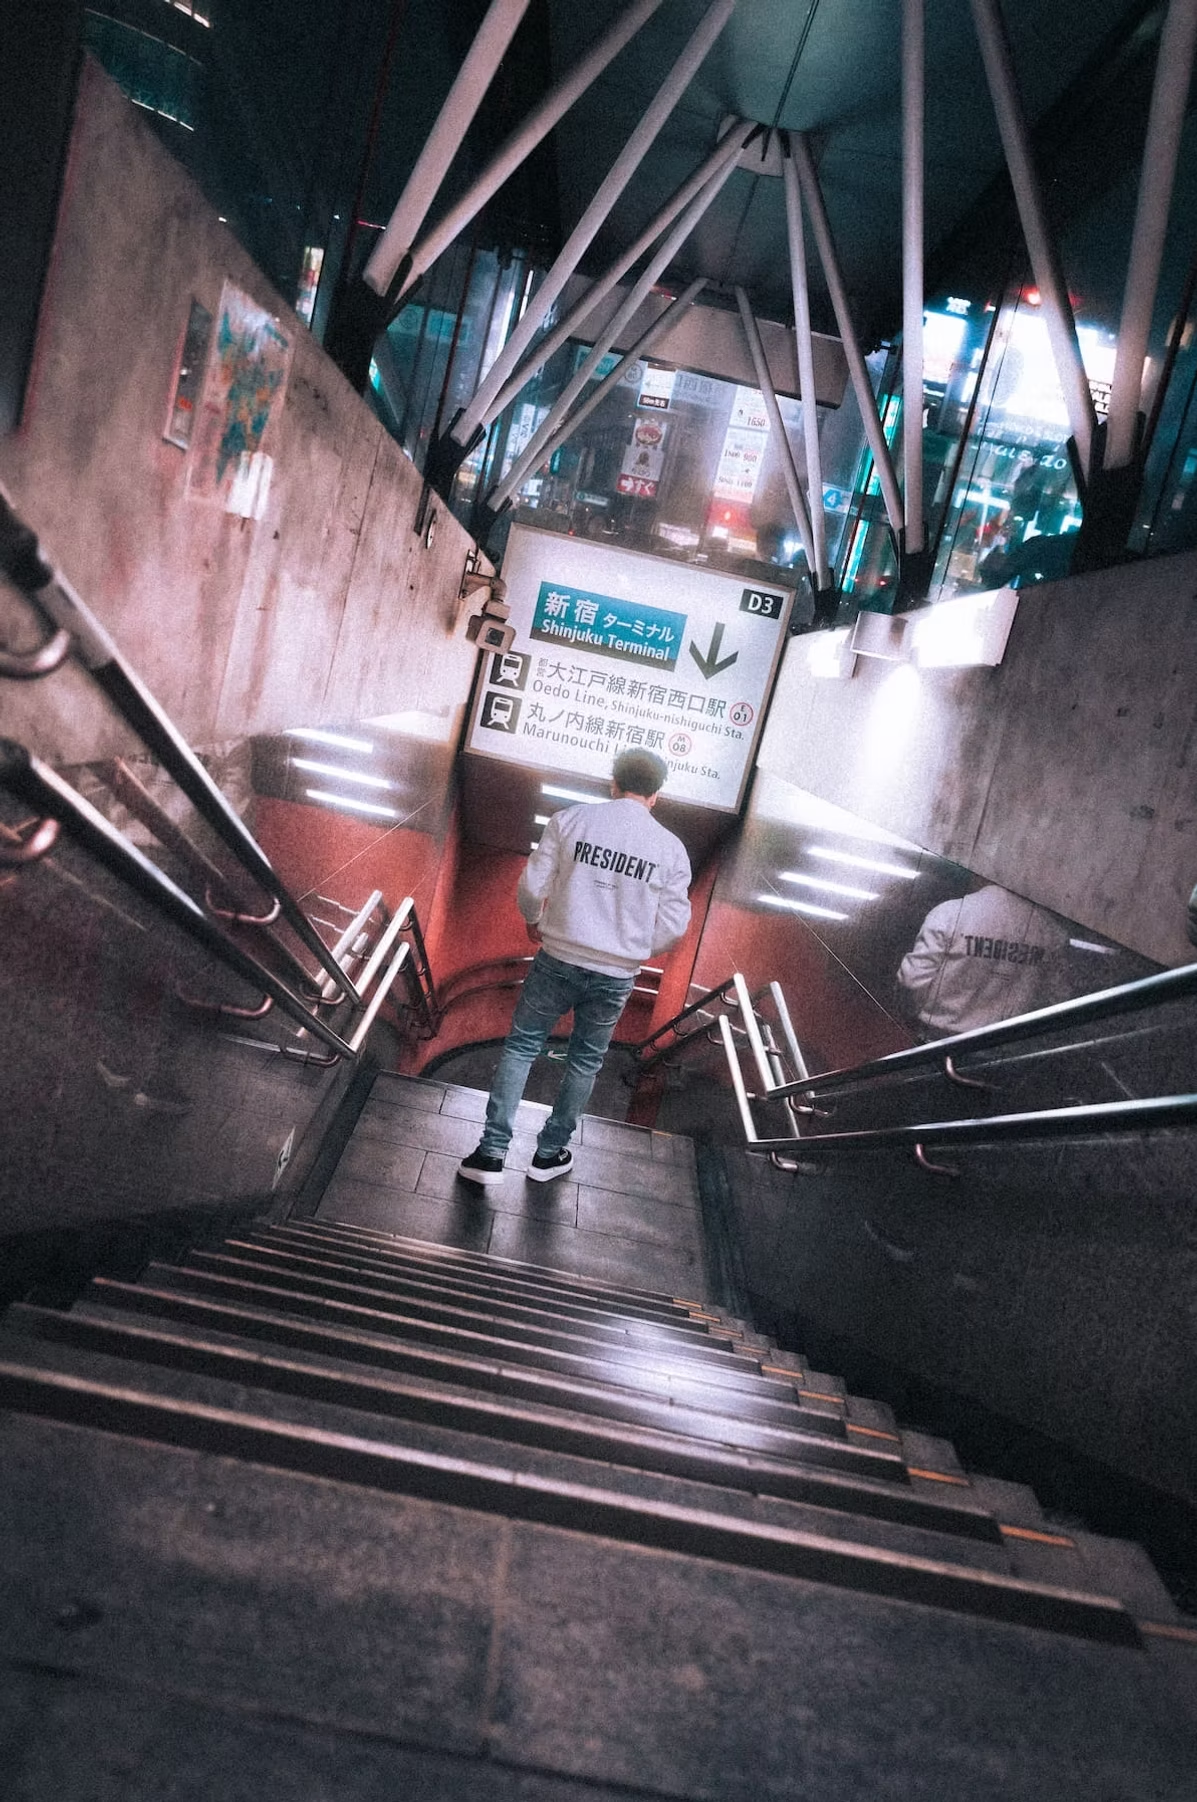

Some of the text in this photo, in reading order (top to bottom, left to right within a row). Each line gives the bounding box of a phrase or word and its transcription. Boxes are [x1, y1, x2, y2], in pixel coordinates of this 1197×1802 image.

[544, 591, 675, 643] 新宿 ターミナル
[748, 593, 774, 614] D3
[541, 619, 670, 661] Shinjuku Terminal
[533, 679, 745, 741] Oedo Line, Shinjuku-nishiguchi Sta.
[547, 662, 727, 718] 大江戸線新宿西口駅
[527, 702, 666, 749] 丸ノ内線新宿駅
[733, 712, 748, 723] 01
[523, 722, 609, 753] Marunouchi
[700, 766, 720, 780] Sta.
[672, 742, 687, 753] 08
[573, 841, 656, 883] PRESIDENT
